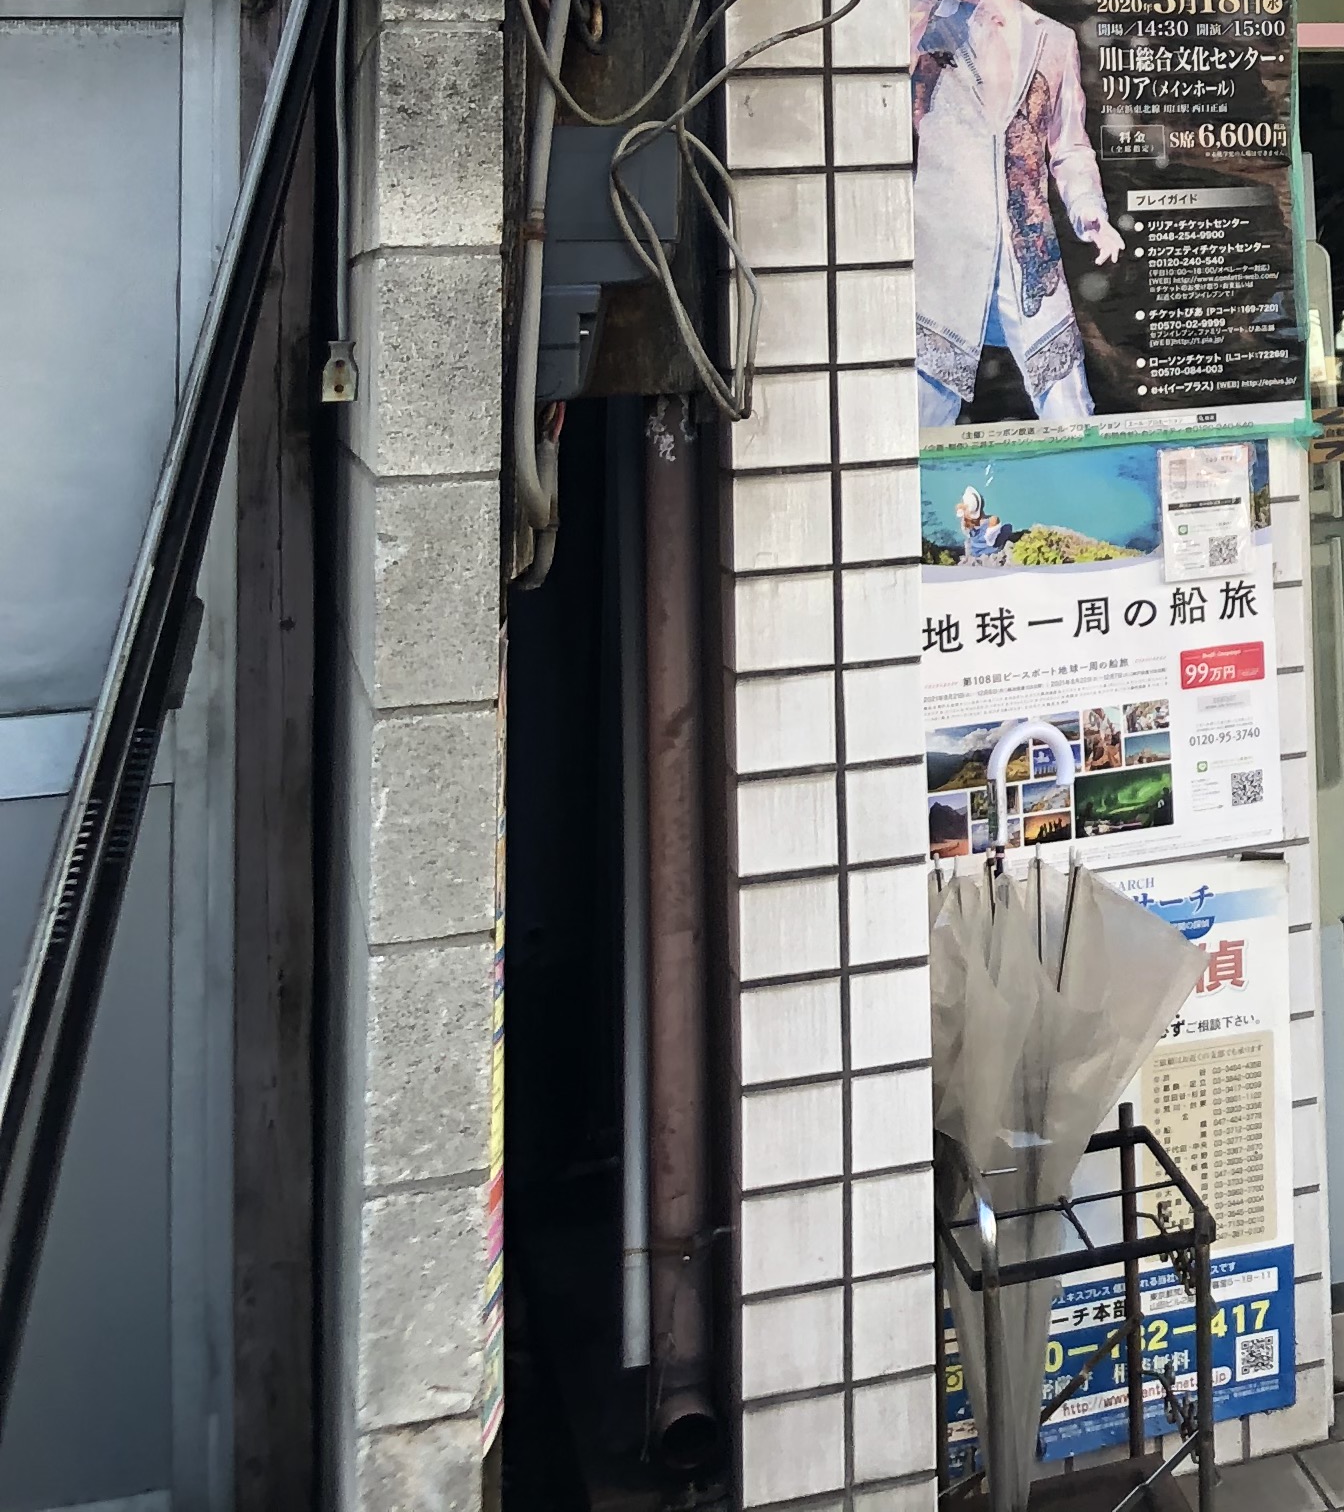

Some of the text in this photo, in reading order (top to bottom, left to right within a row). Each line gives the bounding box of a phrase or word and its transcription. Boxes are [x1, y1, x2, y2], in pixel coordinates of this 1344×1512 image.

[1119, 130, 1146, 144] 料金
[1169, 122, 1287, 149] S席 6,600円
[1136, 193, 1198, 206] プレイガイド
[1148, 218, 1249, 231] リリア・チケットセンター
[1148, 242, 1271, 257] カンフェティチケットセンター
[1149, 306, 1203, 320] チケットぴあ
[1149, 356, 1222, 368] ローソンチケット
[921, 579, 1259, 653] 地球一周の船旅
[1185, 662, 1236, 685] 99万円
[1189, 727, 1261, 747] 0120-95-3740
[1161, 1014, 1261, 1039] ずご相談下さい。
